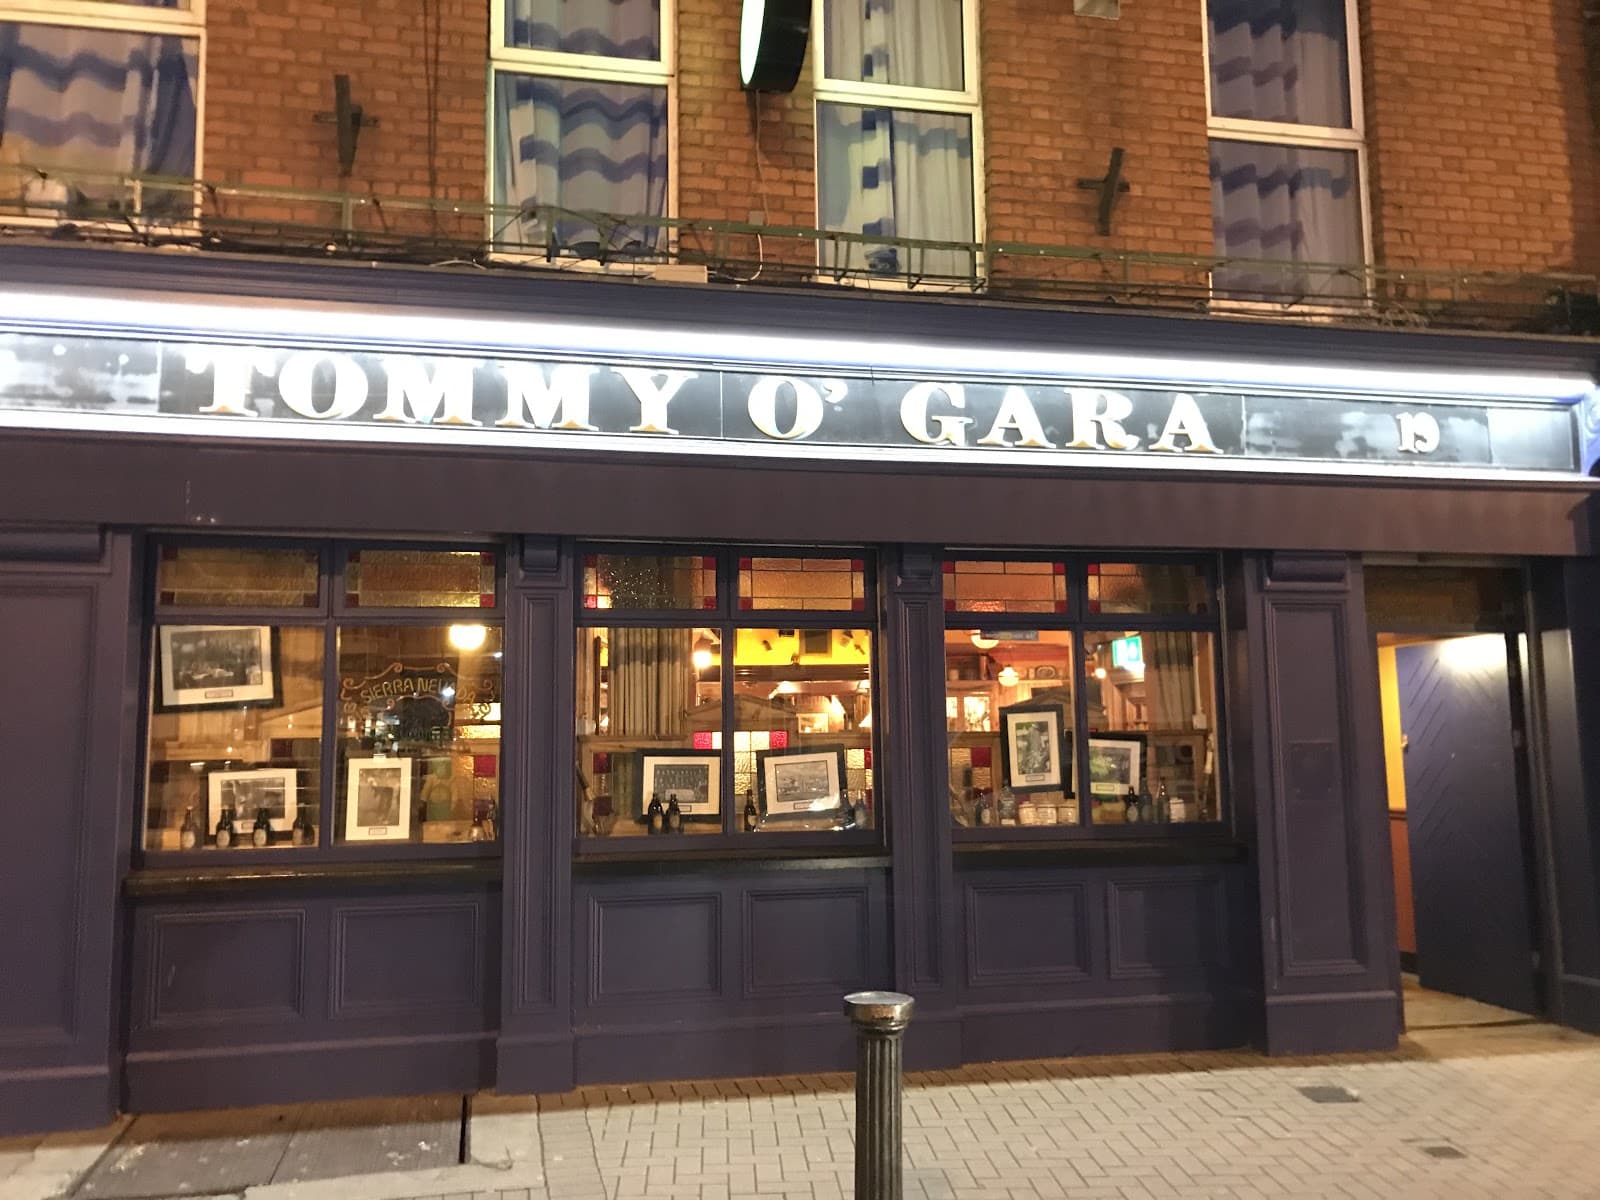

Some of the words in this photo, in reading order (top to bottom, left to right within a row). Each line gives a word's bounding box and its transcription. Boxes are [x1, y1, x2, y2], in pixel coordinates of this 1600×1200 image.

[181, 344, 699, 435] TOMMY
[900, 381, 1224, 454] GARA
[1396, 411, 1440, 453] 19
[360, 678, 414, 703] SIERRA
